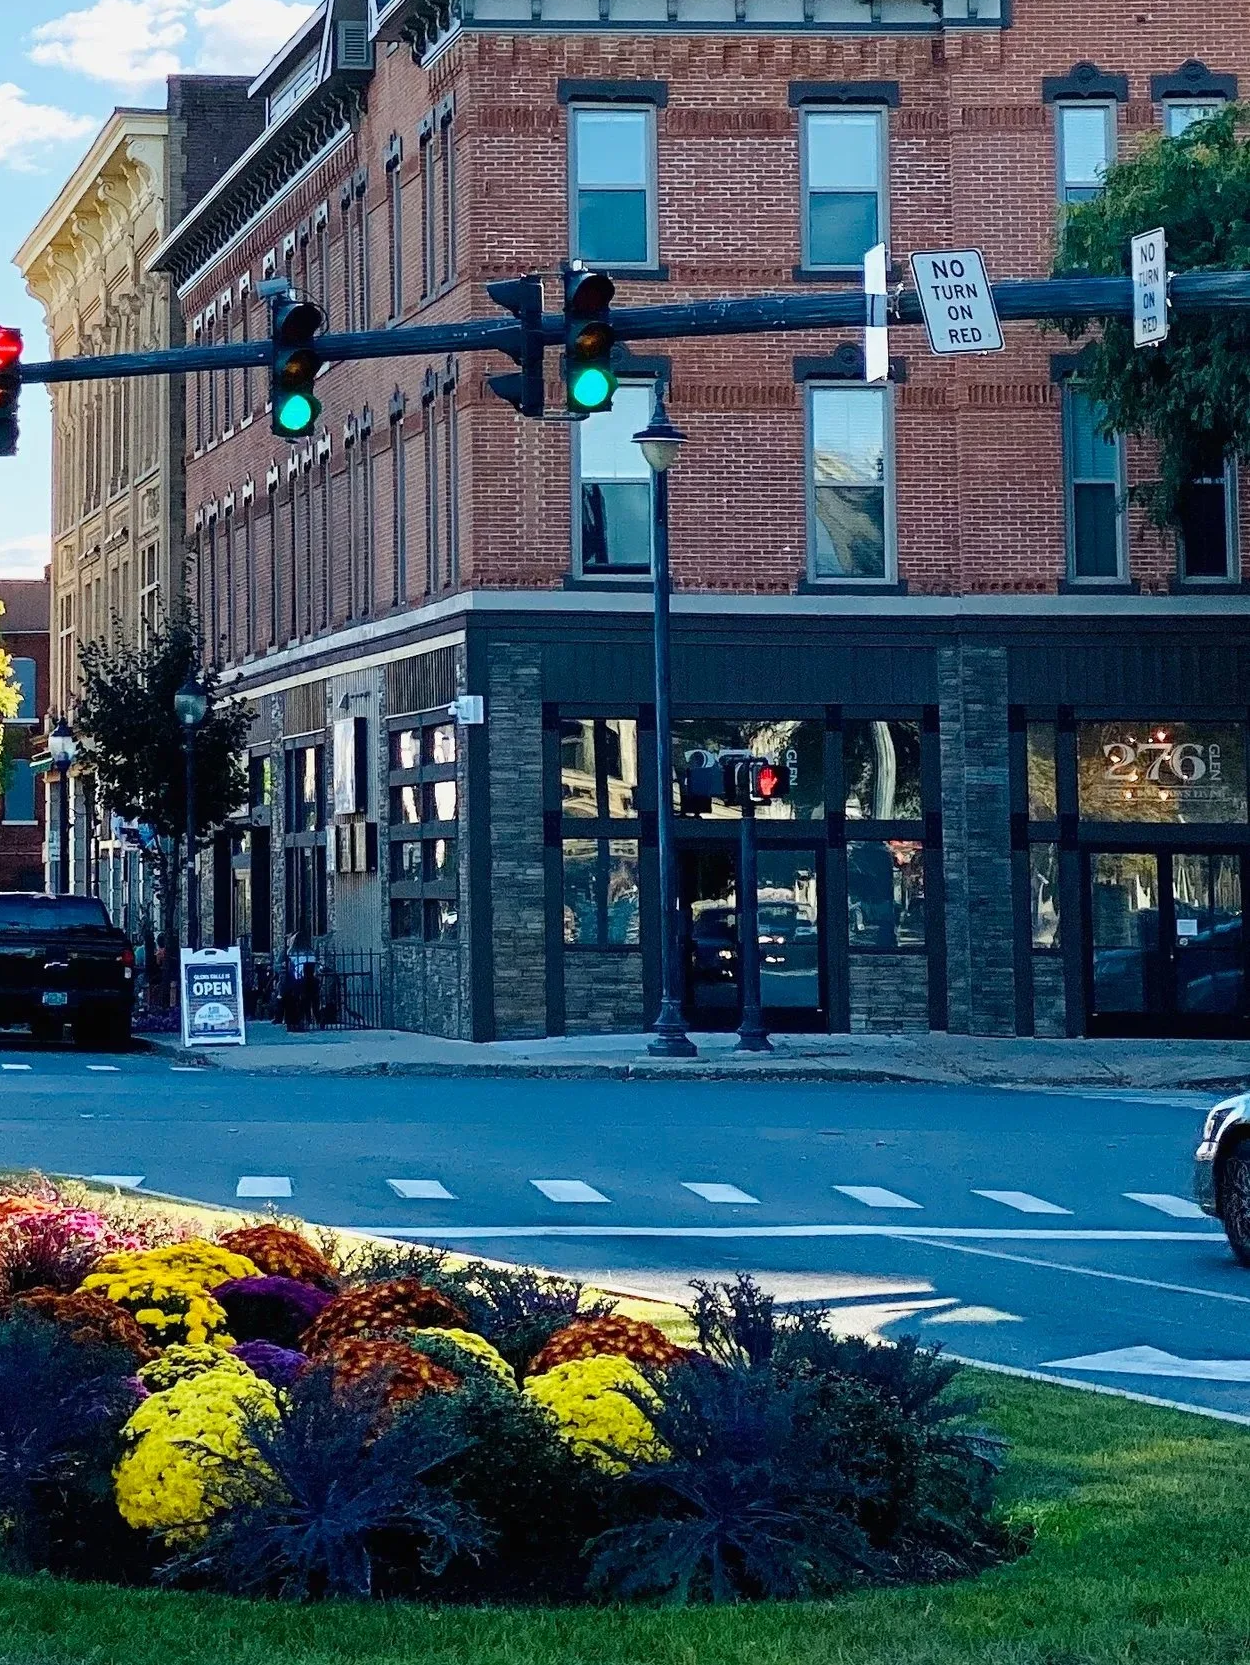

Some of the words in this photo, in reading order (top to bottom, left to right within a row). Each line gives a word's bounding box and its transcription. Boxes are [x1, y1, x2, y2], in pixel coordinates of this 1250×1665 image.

[1140, 242, 1156, 265] NO
[931, 259, 965, 279] NO
[1138, 267, 1159, 288] TURN
[931, 283, 978, 301] TURN
[1143, 291, 1156, 309] ON
[947, 304, 974, 321] ON
[1142, 315, 1158, 335] RED
[948, 327, 982, 344] RED
[786, 748, 799, 787] GLEN
[1102, 743, 1207, 782] 276
[1208, 743, 1223, 782] GLEN
[192, 981, 233, 996] OPEN
